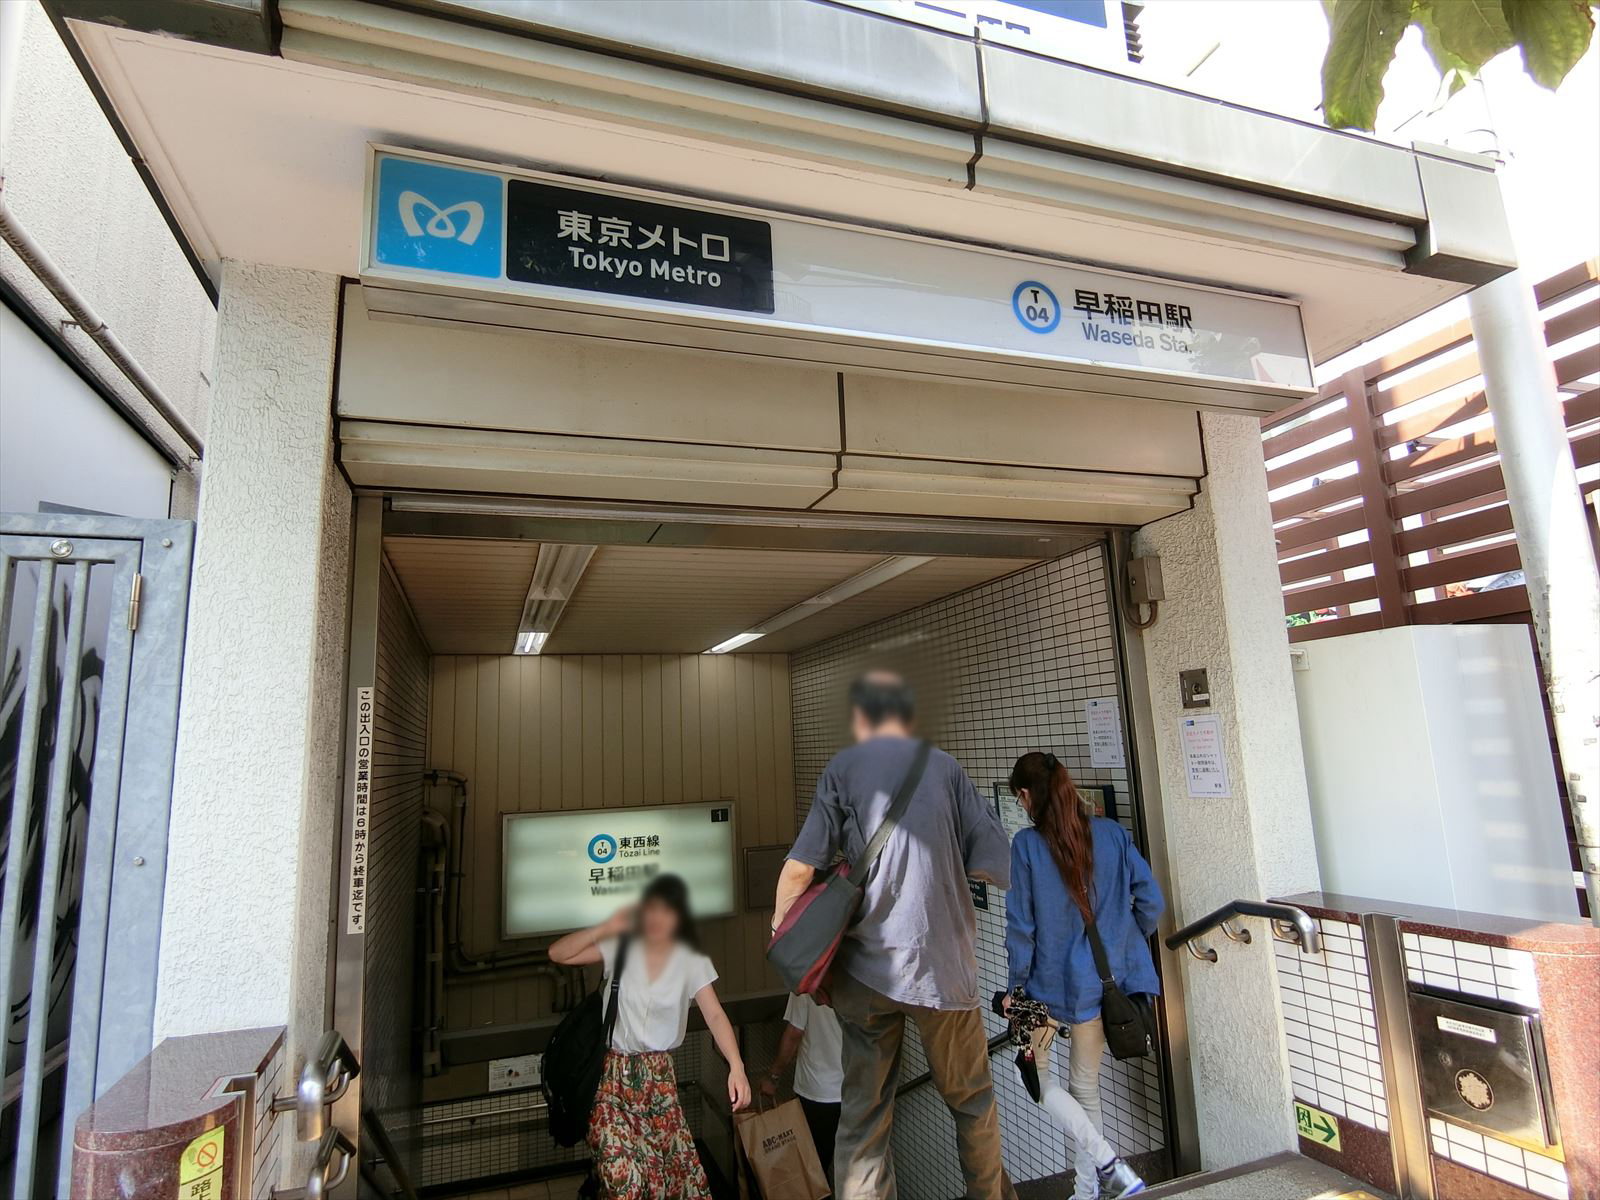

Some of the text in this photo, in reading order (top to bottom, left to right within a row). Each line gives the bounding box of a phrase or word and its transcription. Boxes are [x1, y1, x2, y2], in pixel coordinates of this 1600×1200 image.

[556, 209, 731, 263] 東京メトロ
[568, 246, 722, 288] Tokyo Metro
[1030, 289, 1039, 304] T
[1025, 305, 1050, 323] 04
[1073, 288, 1193, 329] 早稲田駅
[1081, 322, 1193, 354] Waseda Sta.
[717, 810, 722, 821] 1
[619, 834, 660, 849] 東西線
[643, 848, 660, 856] Line
